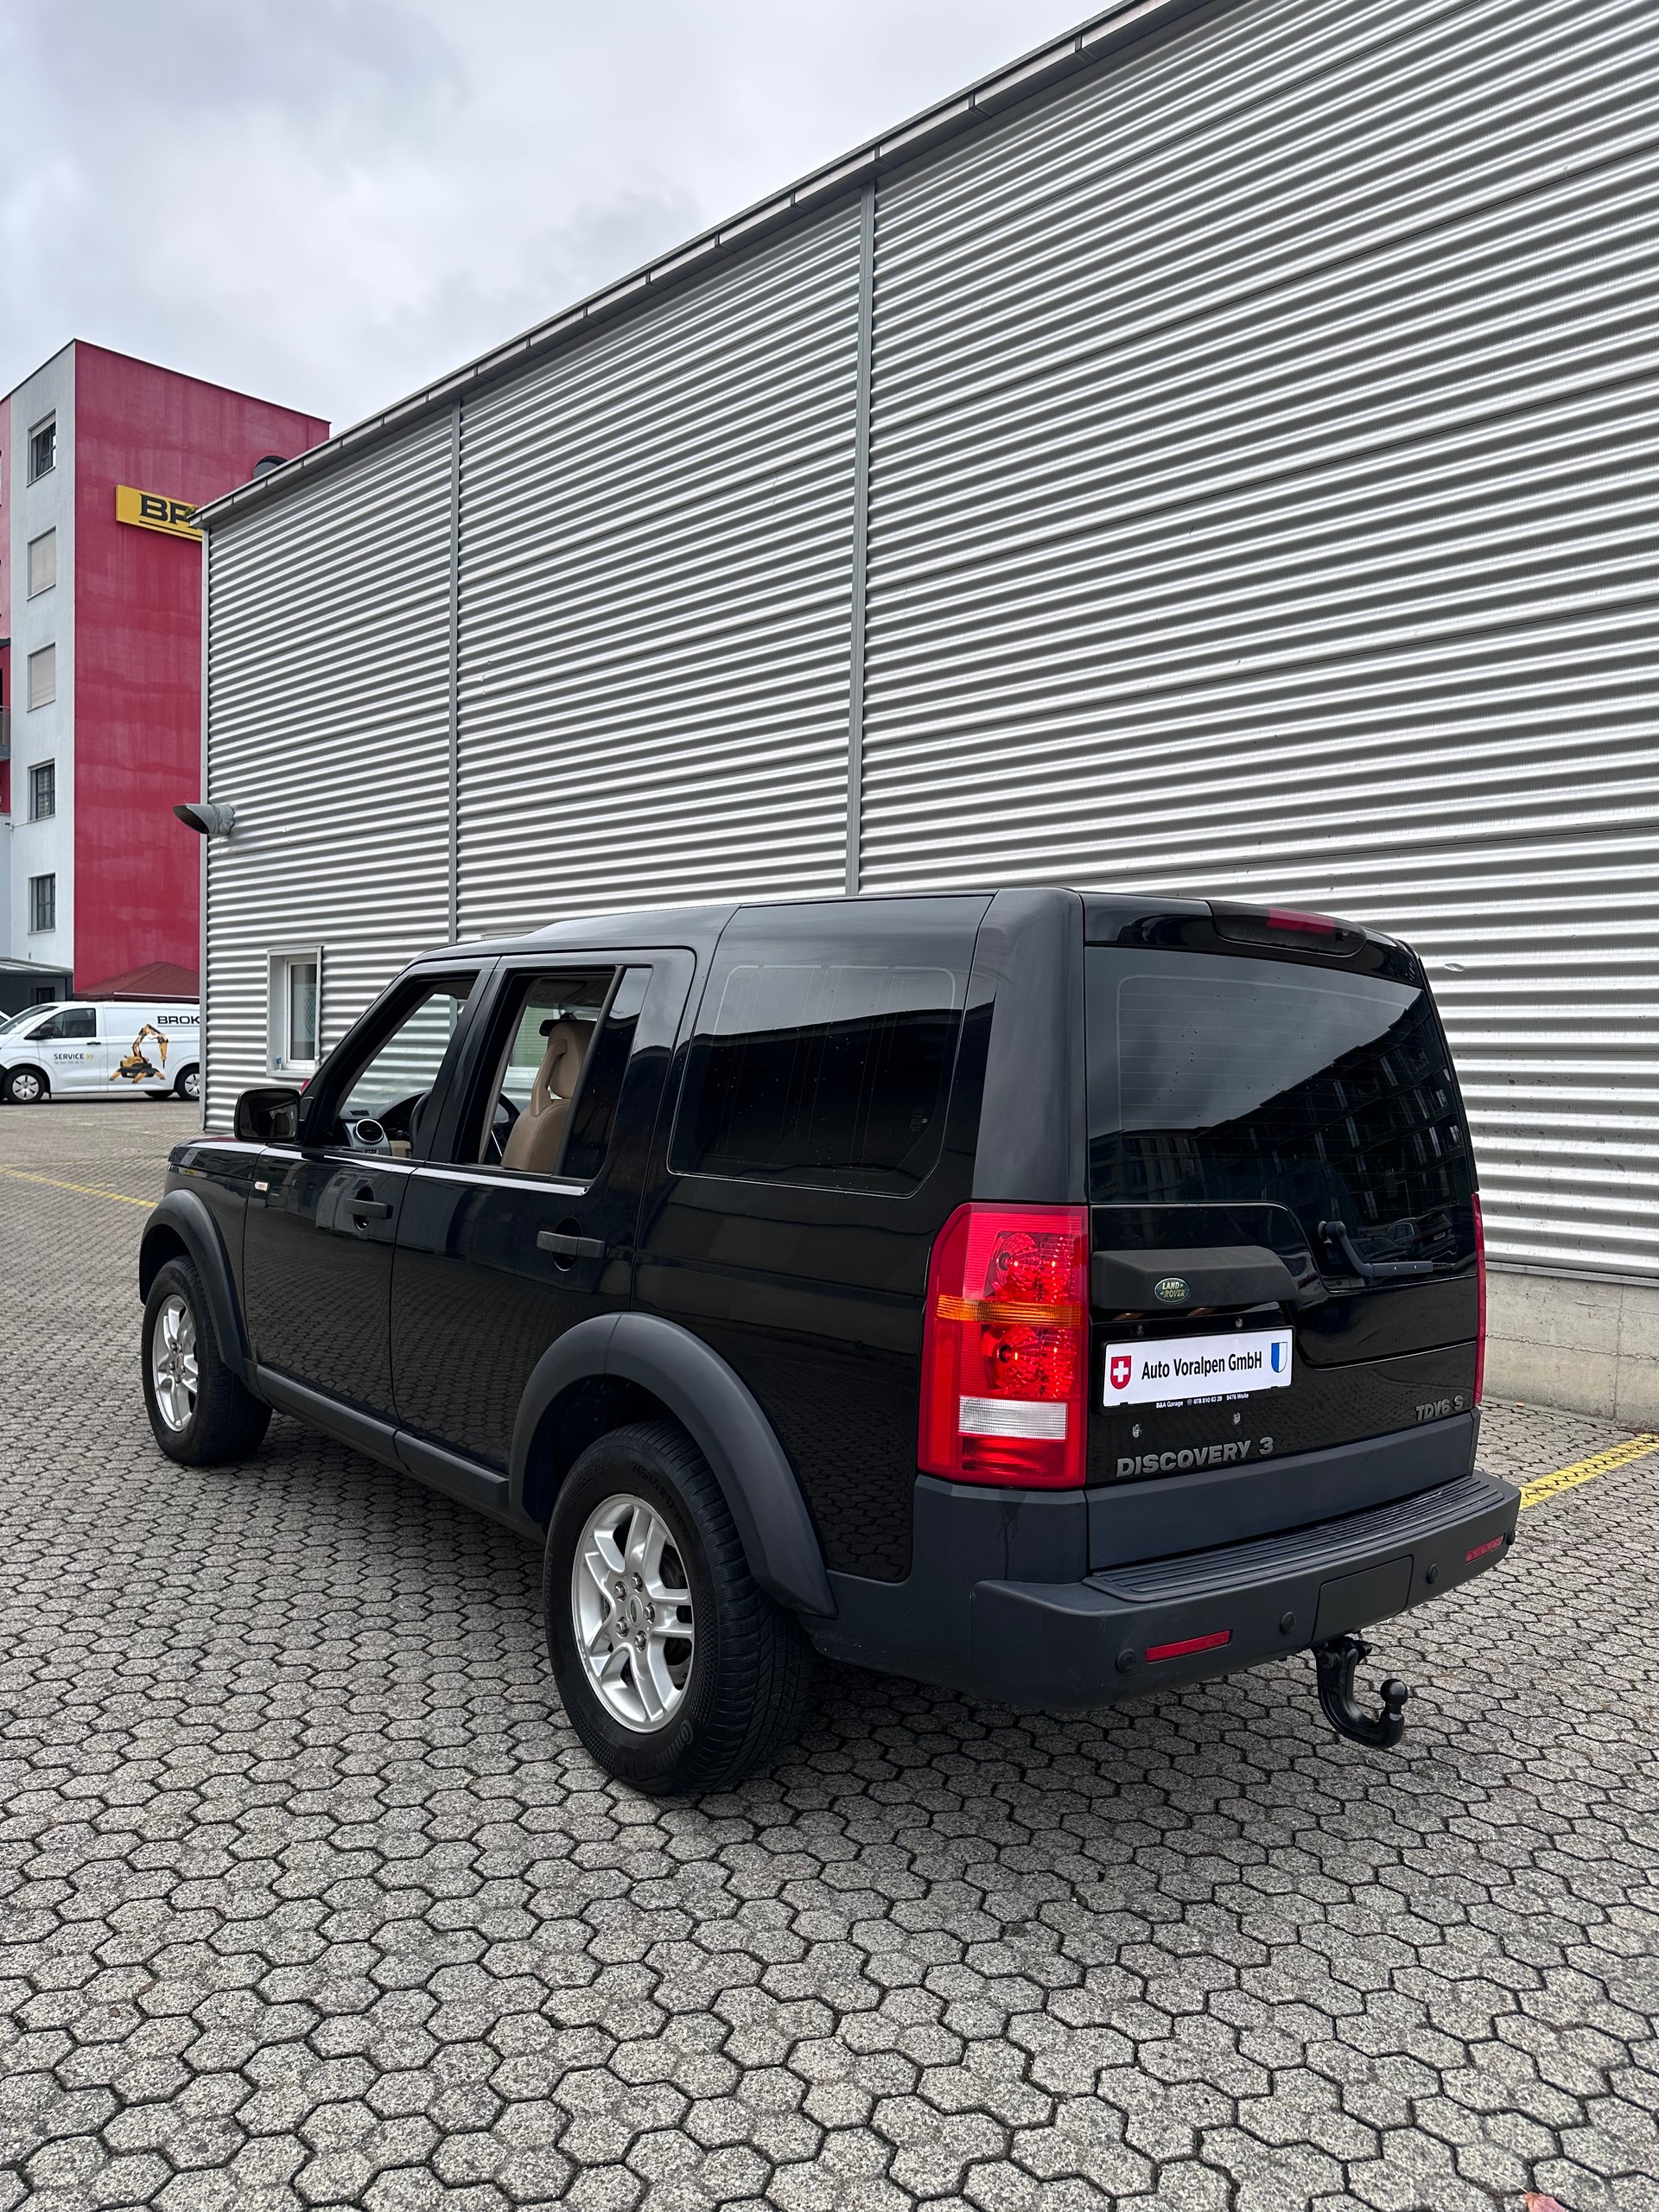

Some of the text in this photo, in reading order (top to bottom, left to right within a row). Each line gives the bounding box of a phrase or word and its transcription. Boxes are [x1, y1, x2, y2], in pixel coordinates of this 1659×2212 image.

[1162, 1281, 1179, 1290] LAND
[1141, 1351, 1262, 1380] Auto Voralpen GmbH
[1416, 1395, 1464, 1421] TDV6 S
[1116, 1436, 1274, 1478] DISCOVERY 3
